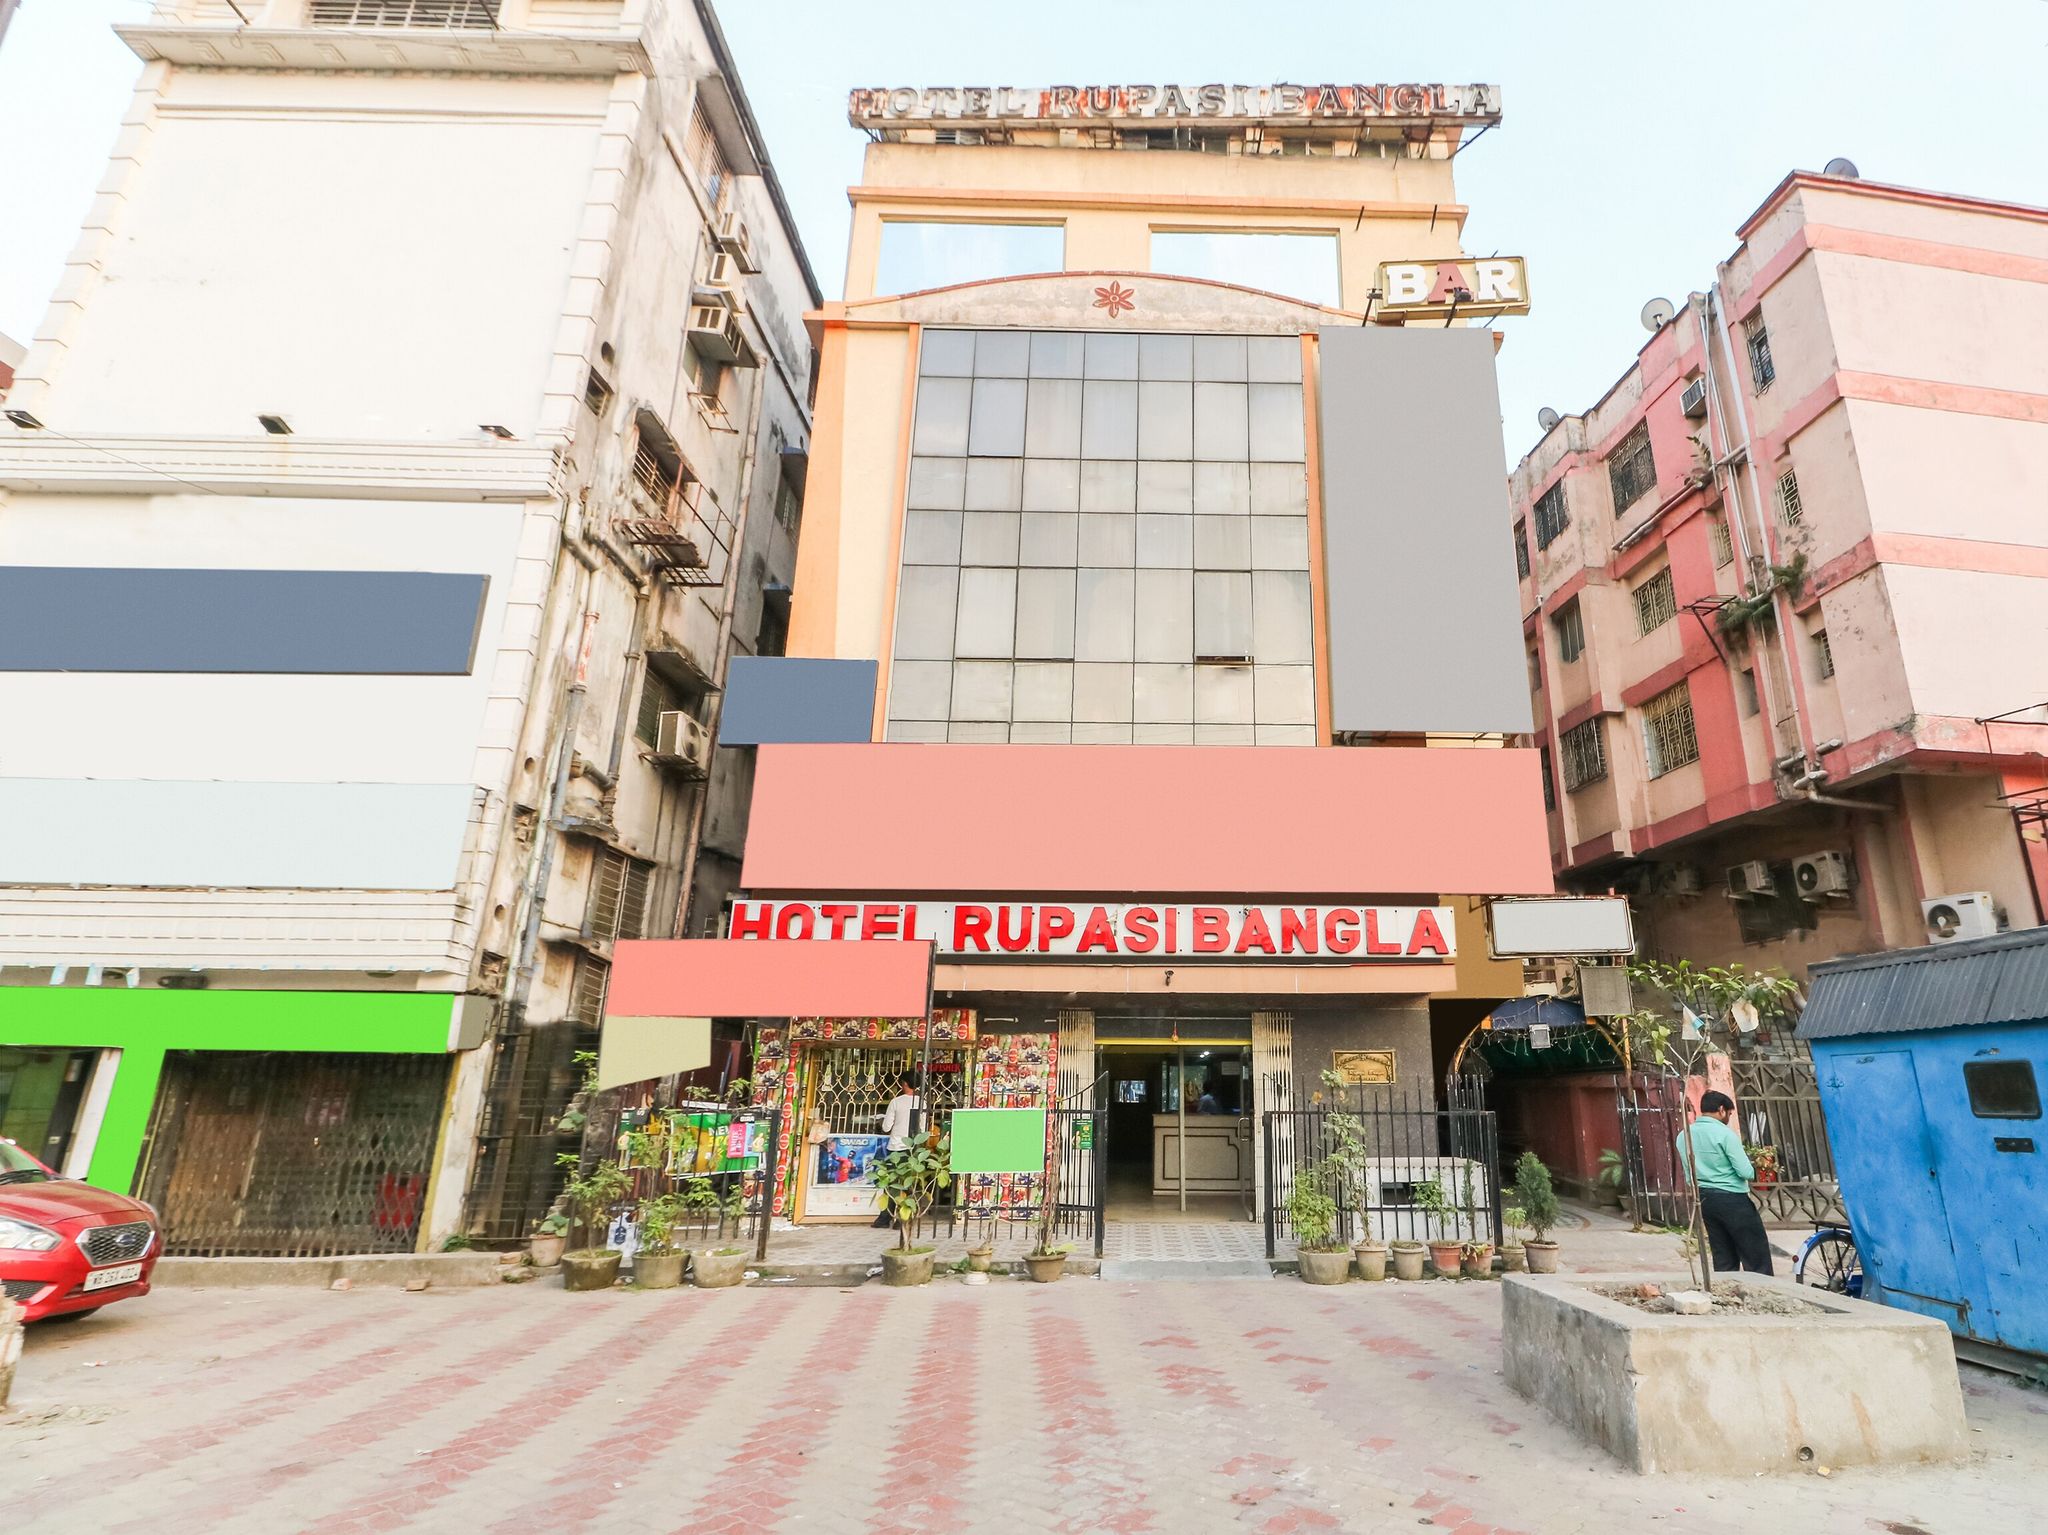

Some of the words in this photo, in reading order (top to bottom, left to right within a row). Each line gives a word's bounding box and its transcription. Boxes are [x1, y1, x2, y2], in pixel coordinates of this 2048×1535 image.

[850, 86, 1032, 119] HOTEL
[1050, 84, 1249, 118] RUPASI
[1271, 83, 1500, 115] BANGLA
[1386, 259, 1522, 306] BAR
[731, 903, 920, 940] HOTEL
[953, 905, 1176, 954] RUPASI
[1192, 907, 1449, 955] BANGLA
